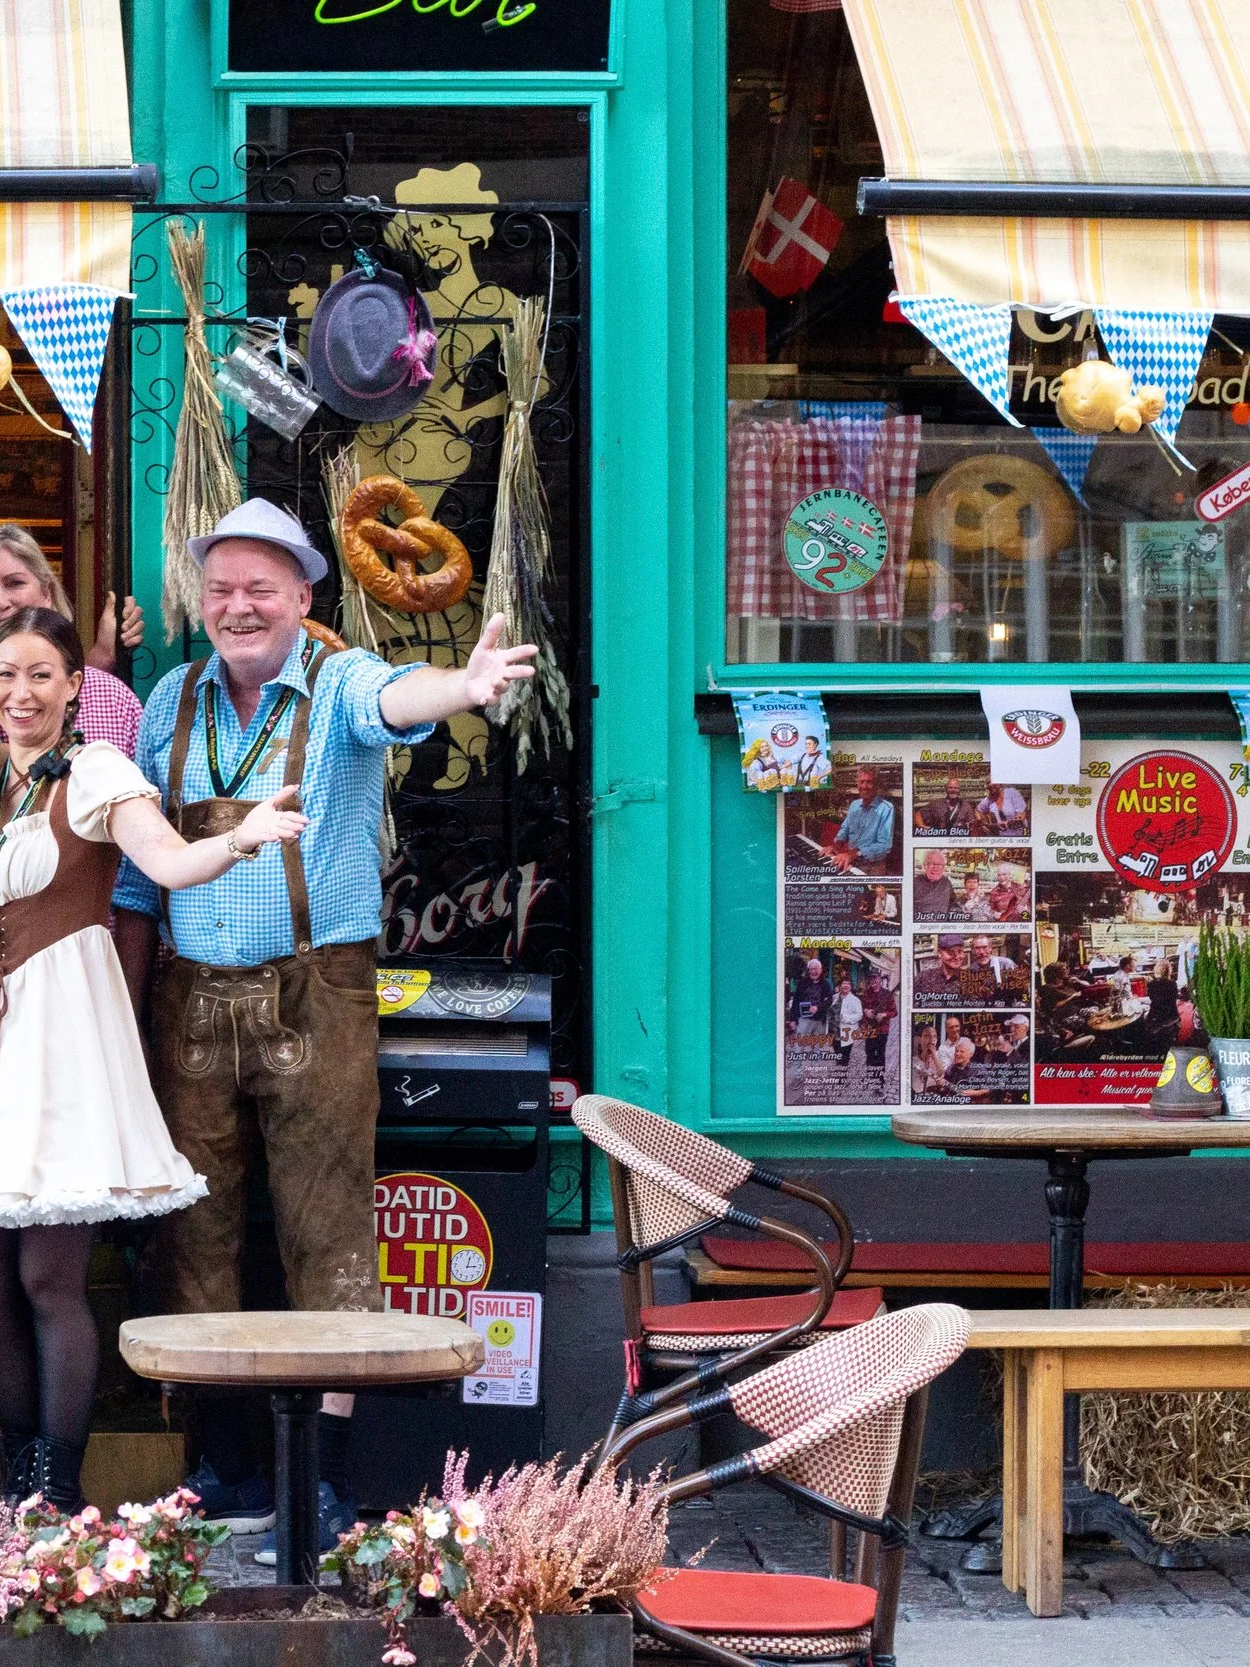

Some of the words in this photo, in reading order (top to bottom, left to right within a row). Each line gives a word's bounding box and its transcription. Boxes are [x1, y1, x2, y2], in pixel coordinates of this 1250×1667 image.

[1209, 477, 1250, 513] Købe
[799, 489, 887, 562] JERNBANECAFEEN
[793, 539, 848, 589] 92
[752, 703, 808, 711] ERDINGER
[1139, 764, 1197, 789] Live
[1116, 788, 1198, 814] Music
[914, 827, 948, 836] Madam
[950, 827, 970, 836] Bleu
[1046, 832, 1094, 846] Gratis
[1056, 849, 1100, 864] Entre
[785, 865, 838, 875] Spillemand
[785, 874, 822, 882] Torsten
[916, 911, 935, 920] Just
[949, 911, 970, 920] Time
[431, 983, 444, 999] WE
[447, 995, 482, 1014] LOVE
[487, 975, 527, 1014] COFFEE
[914, 992, 958, 1002] OgMorten
[1218, 1049, 1250, 1066] FLEUR
[1040, 1067, 1055, 1079] Alt
[1056, 1067, 1077, 1079] kan
[1100, 1067, 1118, 1079] Alle
[1119, 1070, 1130, 1078] er
[1131, 1068, 1161, 1079] velkom
[1101, 1084, 1135, 1095] Musical
[379, 1242, 486, 1286] LTID
[384, 1286, 464, 1317] LTID
[474, 1300, 531, 1318] SMILE!
[489, 1350, 512, 1358] VIDEO
[485, 1359, 530, 1367] VEILLANCE
[486, 1366, 495, 1374] IN
[497, 1366, 513, 1374] USE
